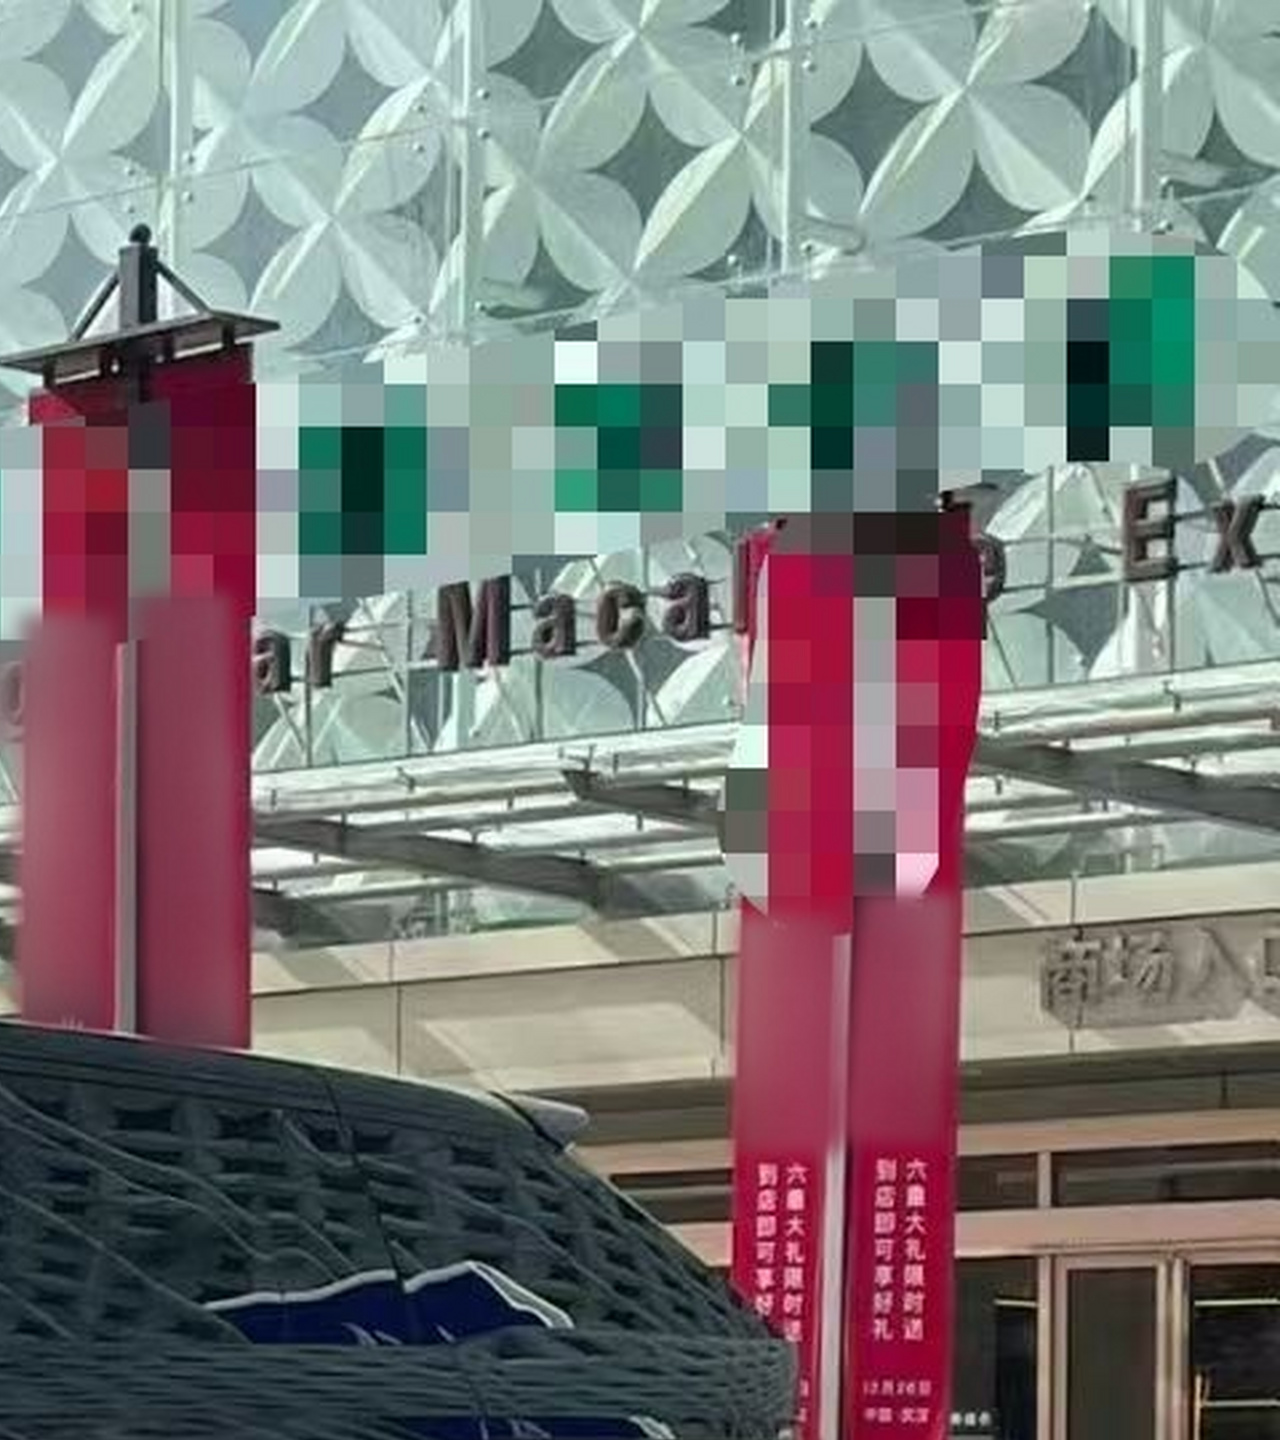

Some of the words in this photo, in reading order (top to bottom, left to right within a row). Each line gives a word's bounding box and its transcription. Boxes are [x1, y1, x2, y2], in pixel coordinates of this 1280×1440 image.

[755, 1164, 778, 1316] 到店即可享好
